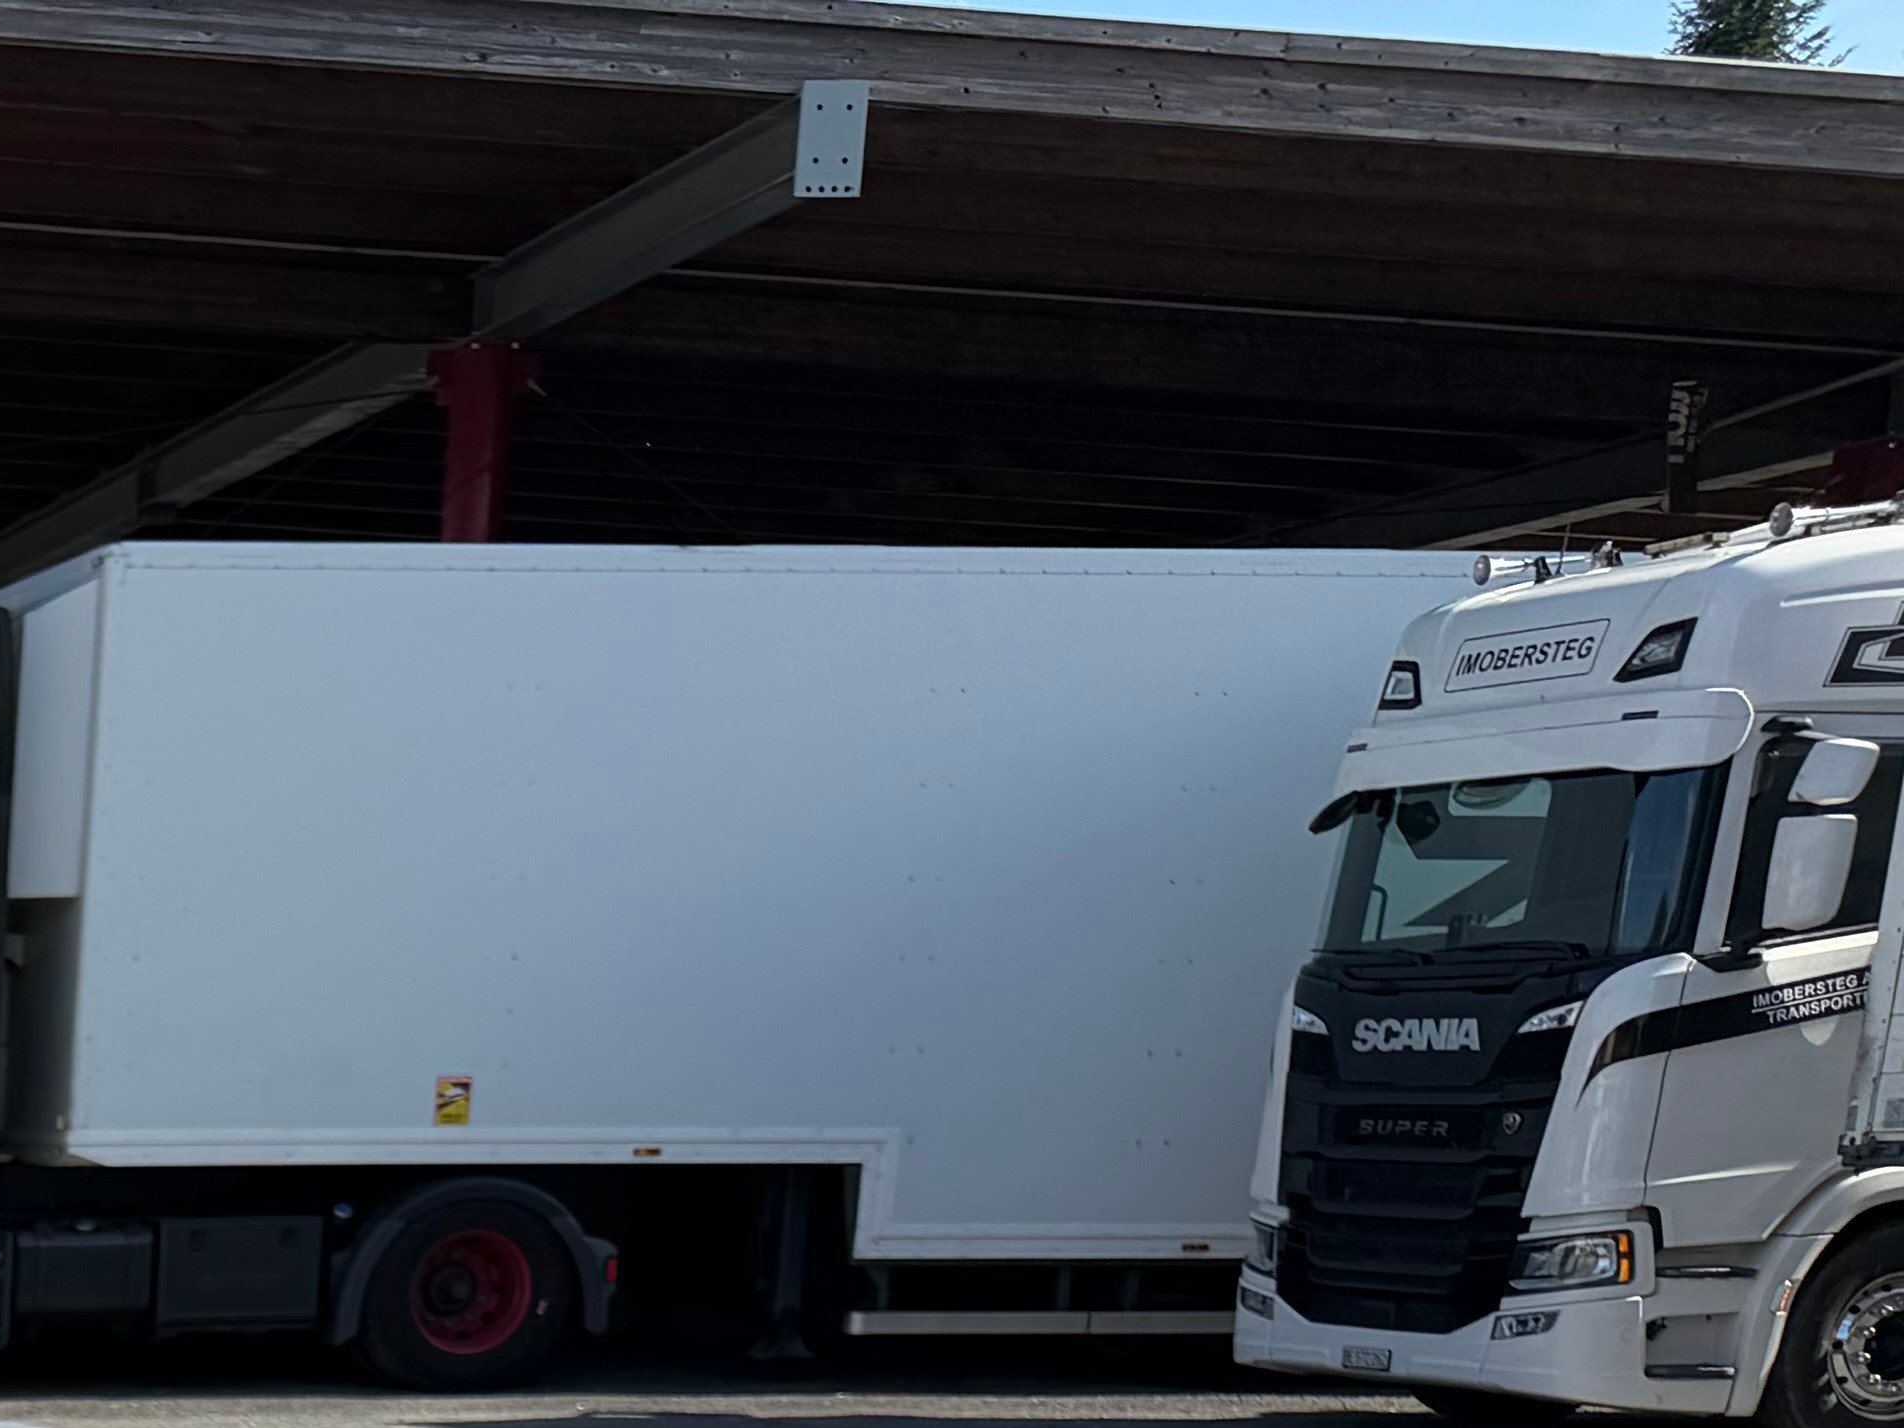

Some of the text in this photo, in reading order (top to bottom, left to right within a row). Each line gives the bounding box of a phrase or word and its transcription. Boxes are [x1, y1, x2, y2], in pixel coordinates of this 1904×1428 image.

[1455, 636, 1595, 677] IMOBERSTEG
[1752, 974, 1858, 1008] IMOBERSTEG
[1351, 1017, 1481, 1052] SCANIA
[1358, 1119, 1449, 1137] SUPER
